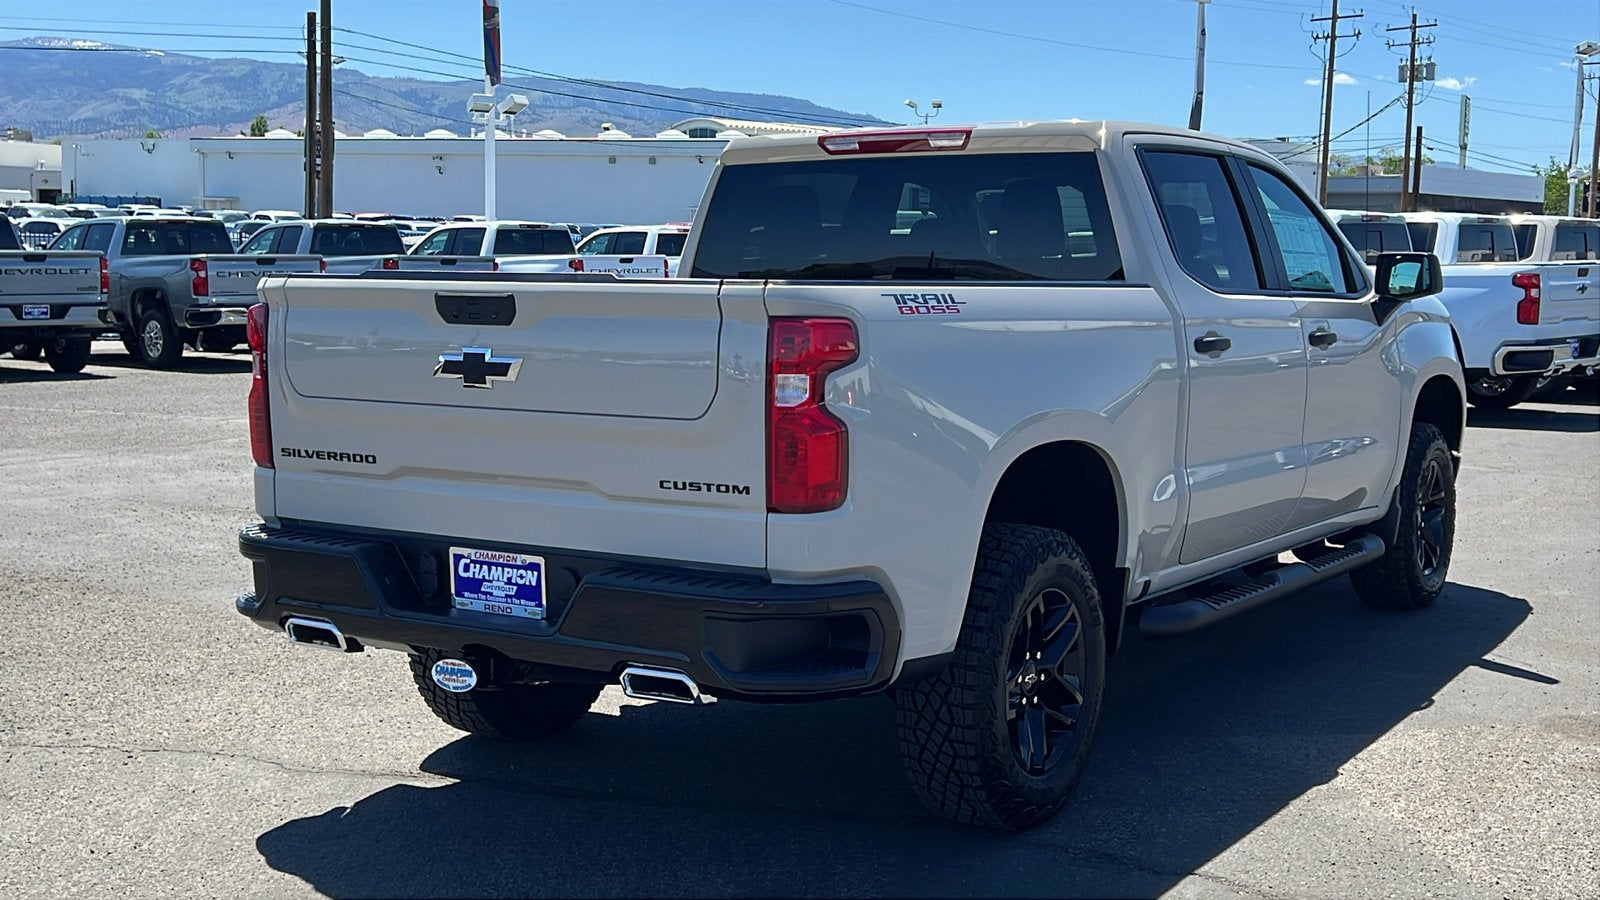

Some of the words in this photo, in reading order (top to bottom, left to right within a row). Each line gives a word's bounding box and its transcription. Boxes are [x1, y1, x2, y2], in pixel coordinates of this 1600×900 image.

[880, 293, 967, 305] TRAIL
[898, 305, 961, 315] BOSS
[280, 447, 377, 465] SILVERADO
[659, 480, 751, 496] CUSTOM
[474, 551, 518, 563] CHAMPION
[458, 558, 538, 586] CHAMPION
[483, 583, 516, 594] CHEVROLET
[484, 603, 513, 614] RENO
